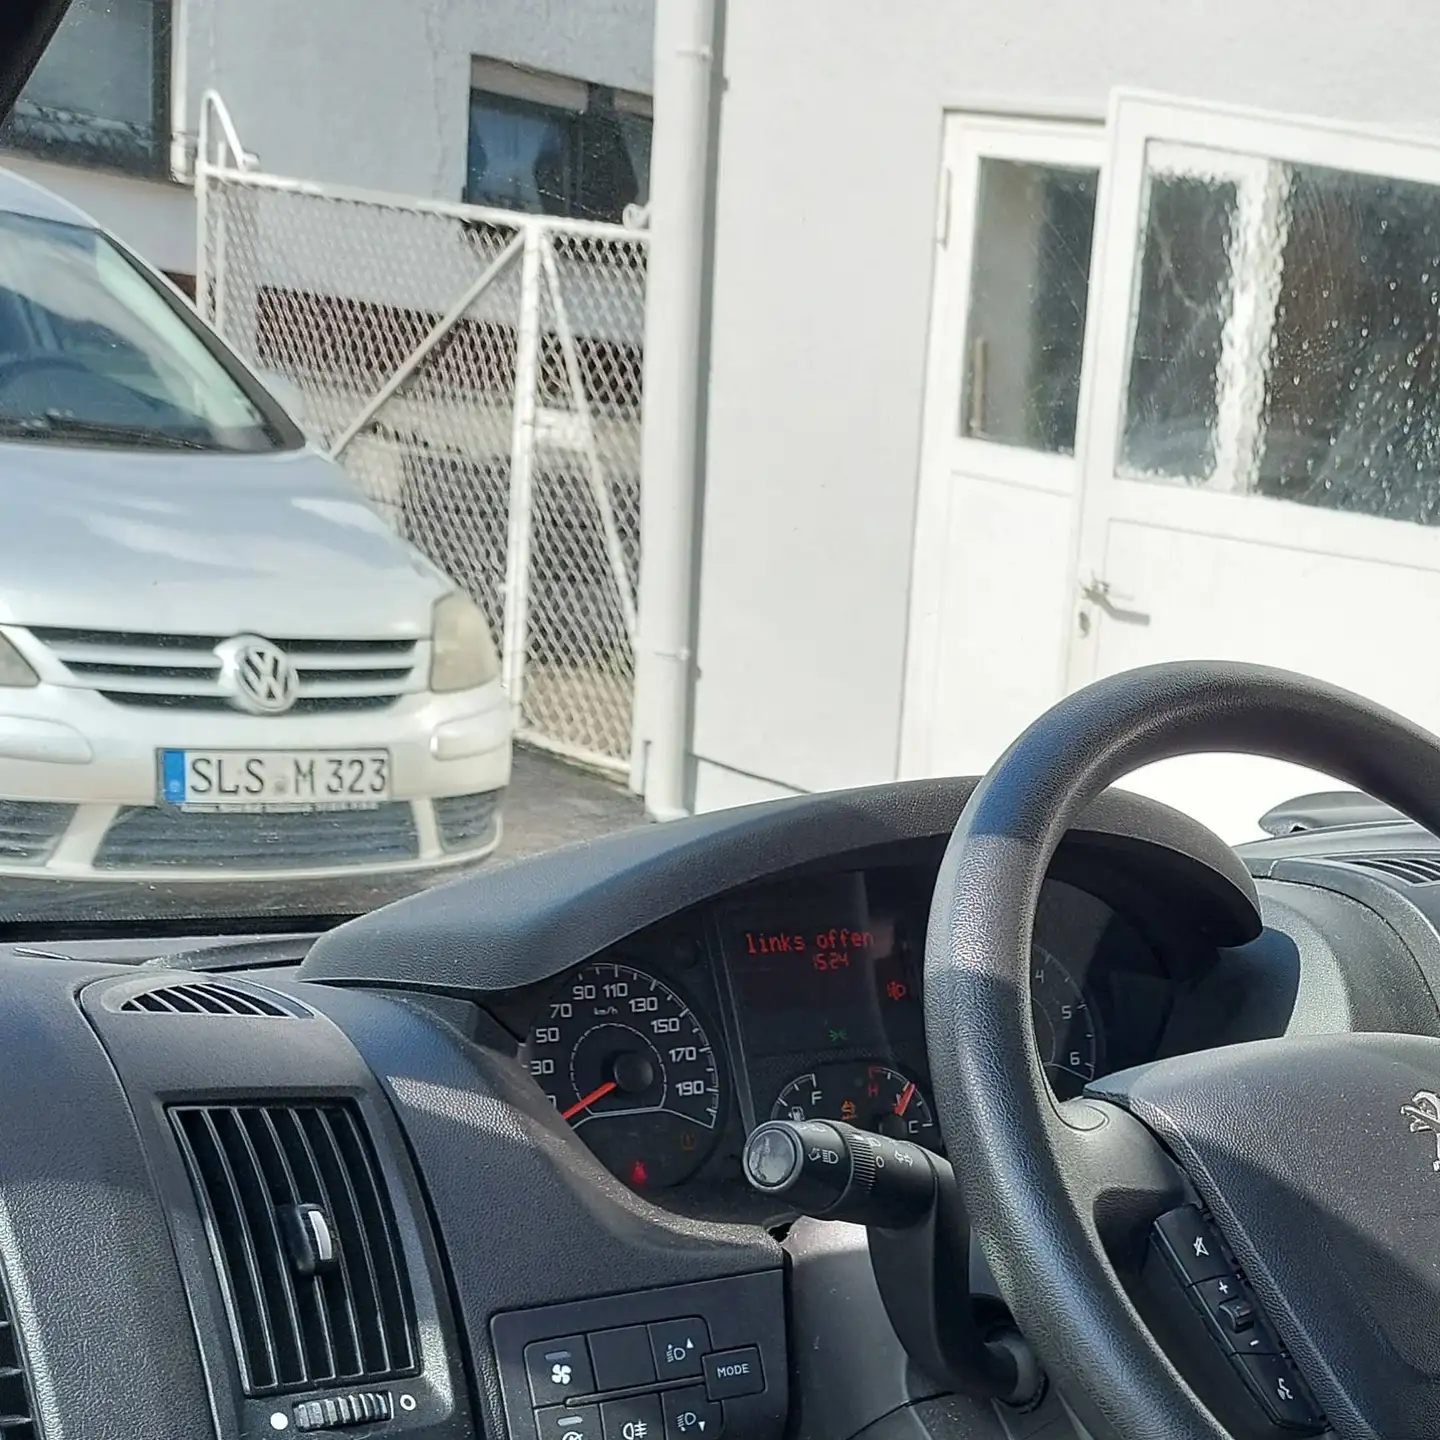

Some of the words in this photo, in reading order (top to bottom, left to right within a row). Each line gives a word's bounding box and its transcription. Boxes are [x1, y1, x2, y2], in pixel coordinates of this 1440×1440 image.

[190, 757, 265, 795] SLS
[294, 758, 316, 795] M
[327, 758, 387, 794] 323
[746, 932, 806, 954] links
[816, 928, 874, 950] offen
[572, 985, 596, 1000] 90
[602, 982, 629, 998] 110
[550, 1003, 572, 1019] 70
[628, 997, 659, 1013] 130
[1061, 1005, 1072, 1020] 5
[650, 1017, 680, 1034] 150
[535, 1027, 560, 1044] 50
[668, 1046, 697, 1063] 170
[1069, 1051, 1080, 1066] 6
[530, 1059, 555, 1076] 30
[675, 1080, 704, 1097] 190
[867, 1084, 879, 1097] H
[810, 1090, 823, 1106] F
[908, 1120, 919, 1135] C
[716, 1363, 751, 1379] MODE
